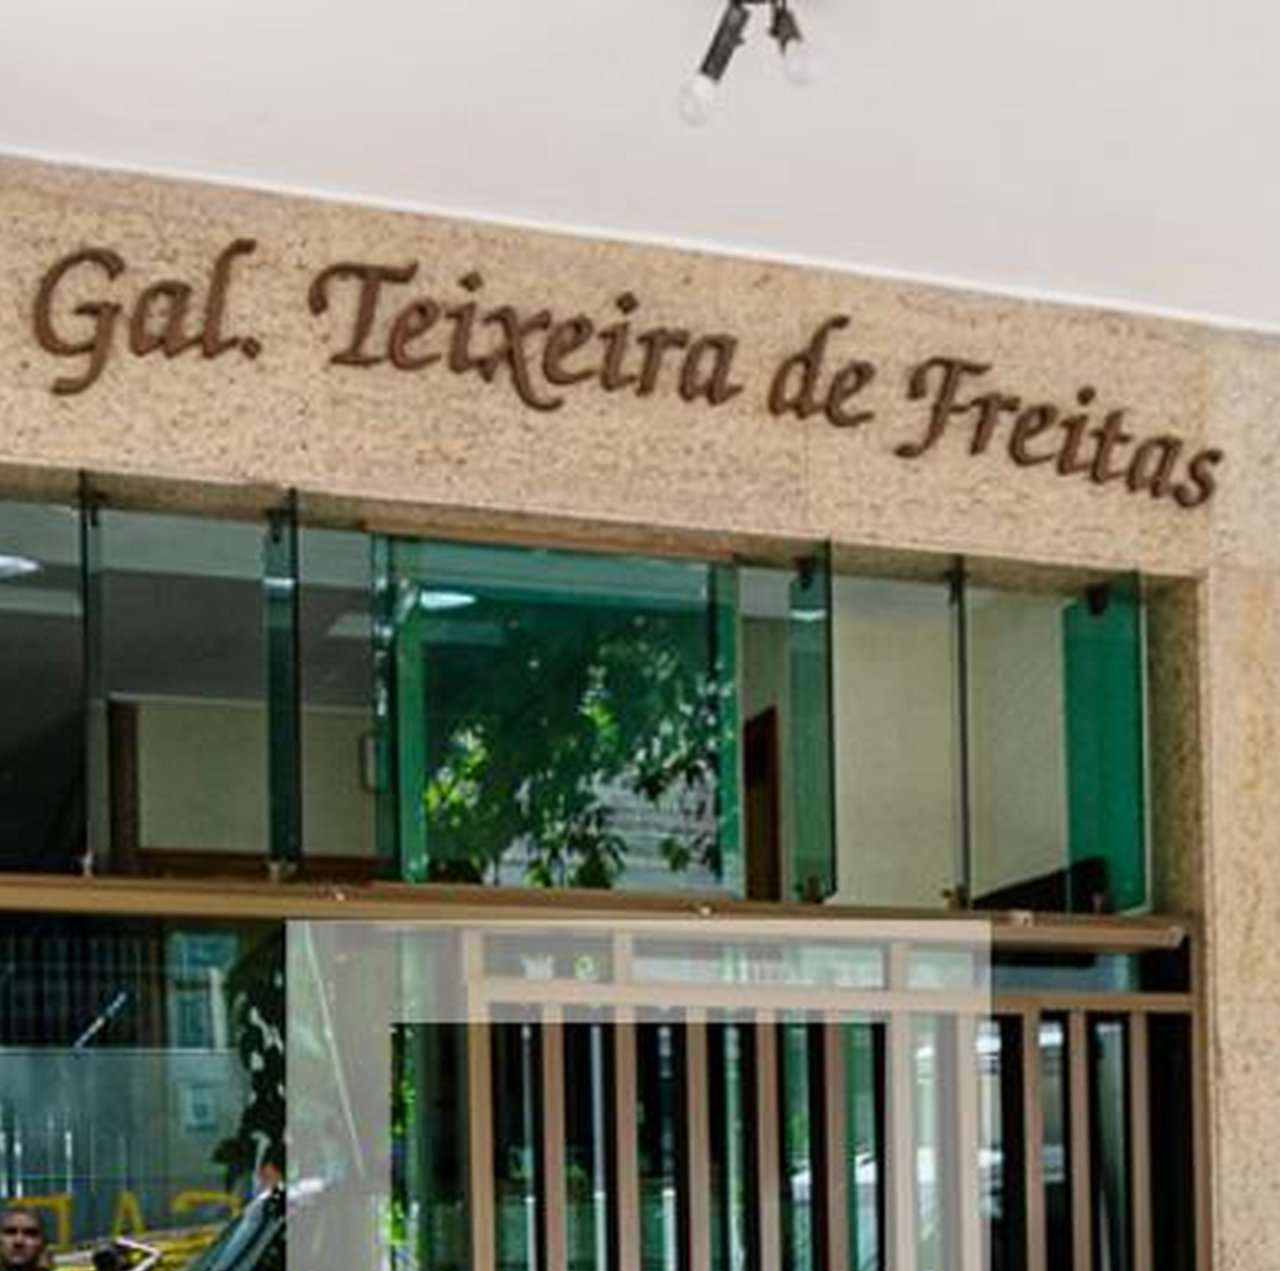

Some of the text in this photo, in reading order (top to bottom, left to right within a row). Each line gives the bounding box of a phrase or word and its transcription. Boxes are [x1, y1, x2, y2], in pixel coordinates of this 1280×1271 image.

[30, 238, 262, 394] Gal.
[308, 260, 742, 412] Teixeira
[766, 314, 876, 429] de
[895, 355, 1225, 510] Freitas
